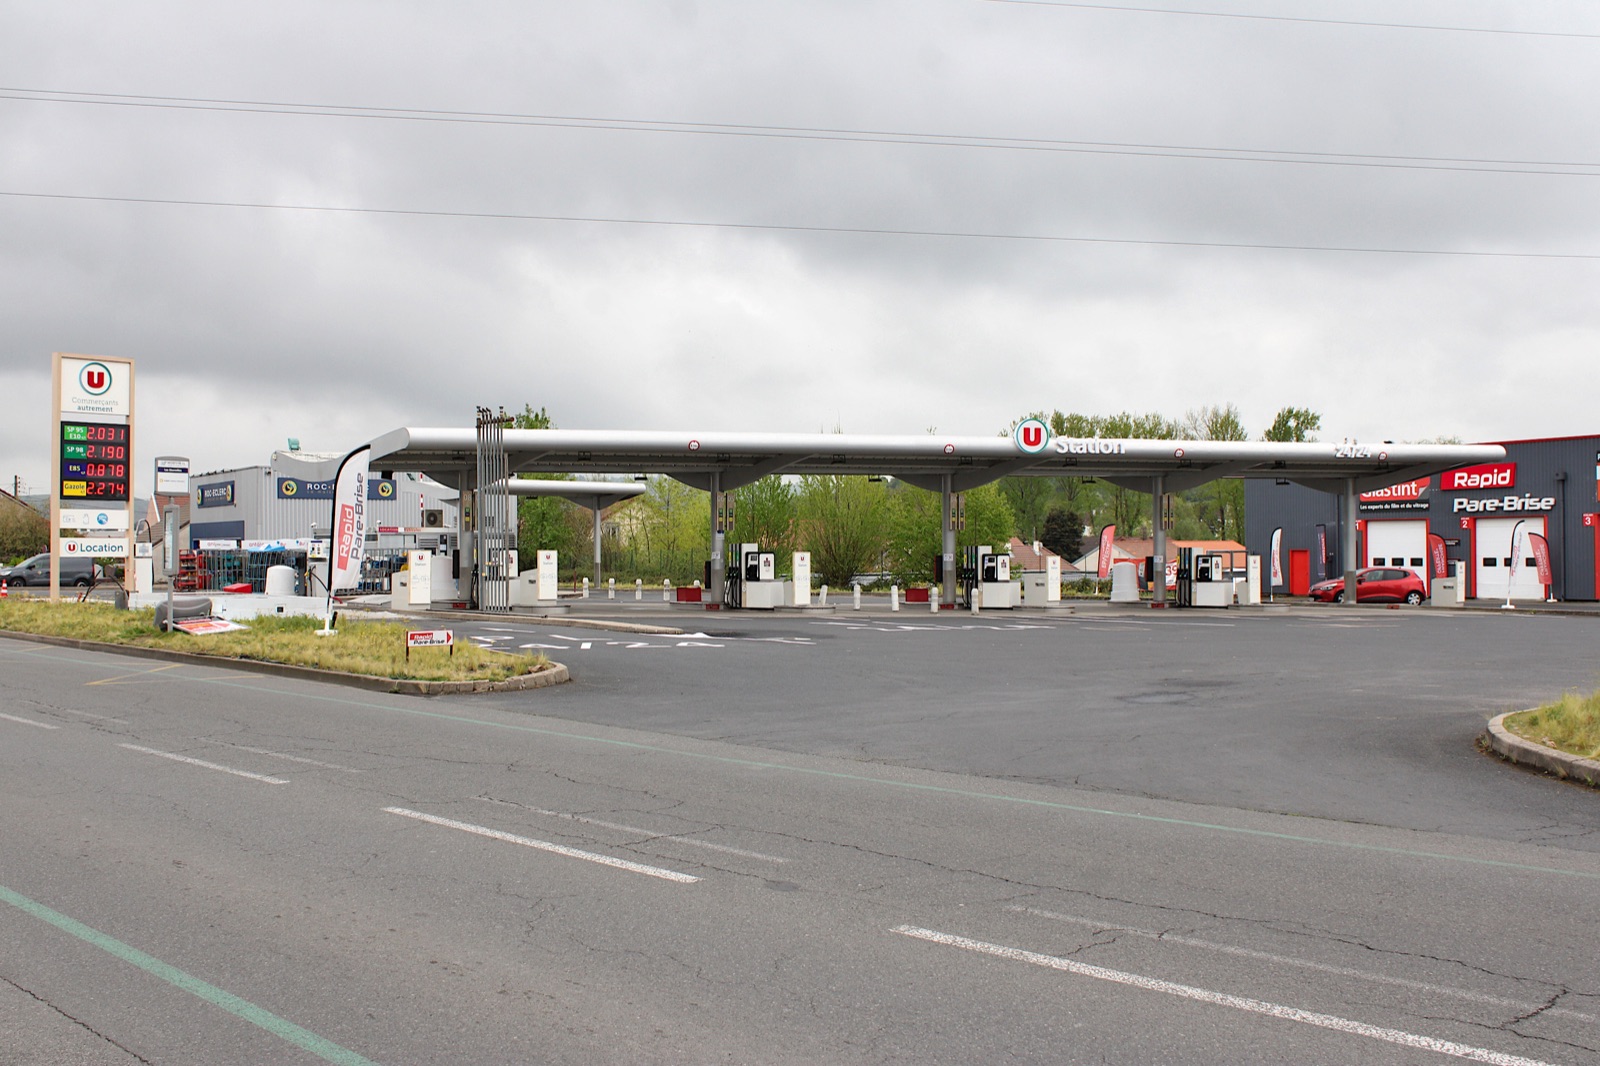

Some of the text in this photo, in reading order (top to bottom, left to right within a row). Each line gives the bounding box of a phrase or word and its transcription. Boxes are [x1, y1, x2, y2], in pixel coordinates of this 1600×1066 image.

[87, 371, 104, 389] U
[72, 397, 119, 406] Commerçants
[87, 427, 124, 440] 2.031
[1023, 427, 1041, 446] U
[86, 445, 124, 459] 2.190
[1057, 436, 1126, 454] Station
[1335, 447, 1371, 459] 24/24
[86, 463, 124, 477] 0.878
[1454, 468, 1511, 489] Rapid
[86, 481, 124, 495] 2.274
[1453, 493, 1556, 513] Pare-Brise
[350, 472, 364, 560] Pare-Brise
[1585, 516, 1591, 525] 3
[1462, 520, 1468, 528] 2
[340, 508, 353, 557] Rapid
[68, 543, 124, 552] U Location
